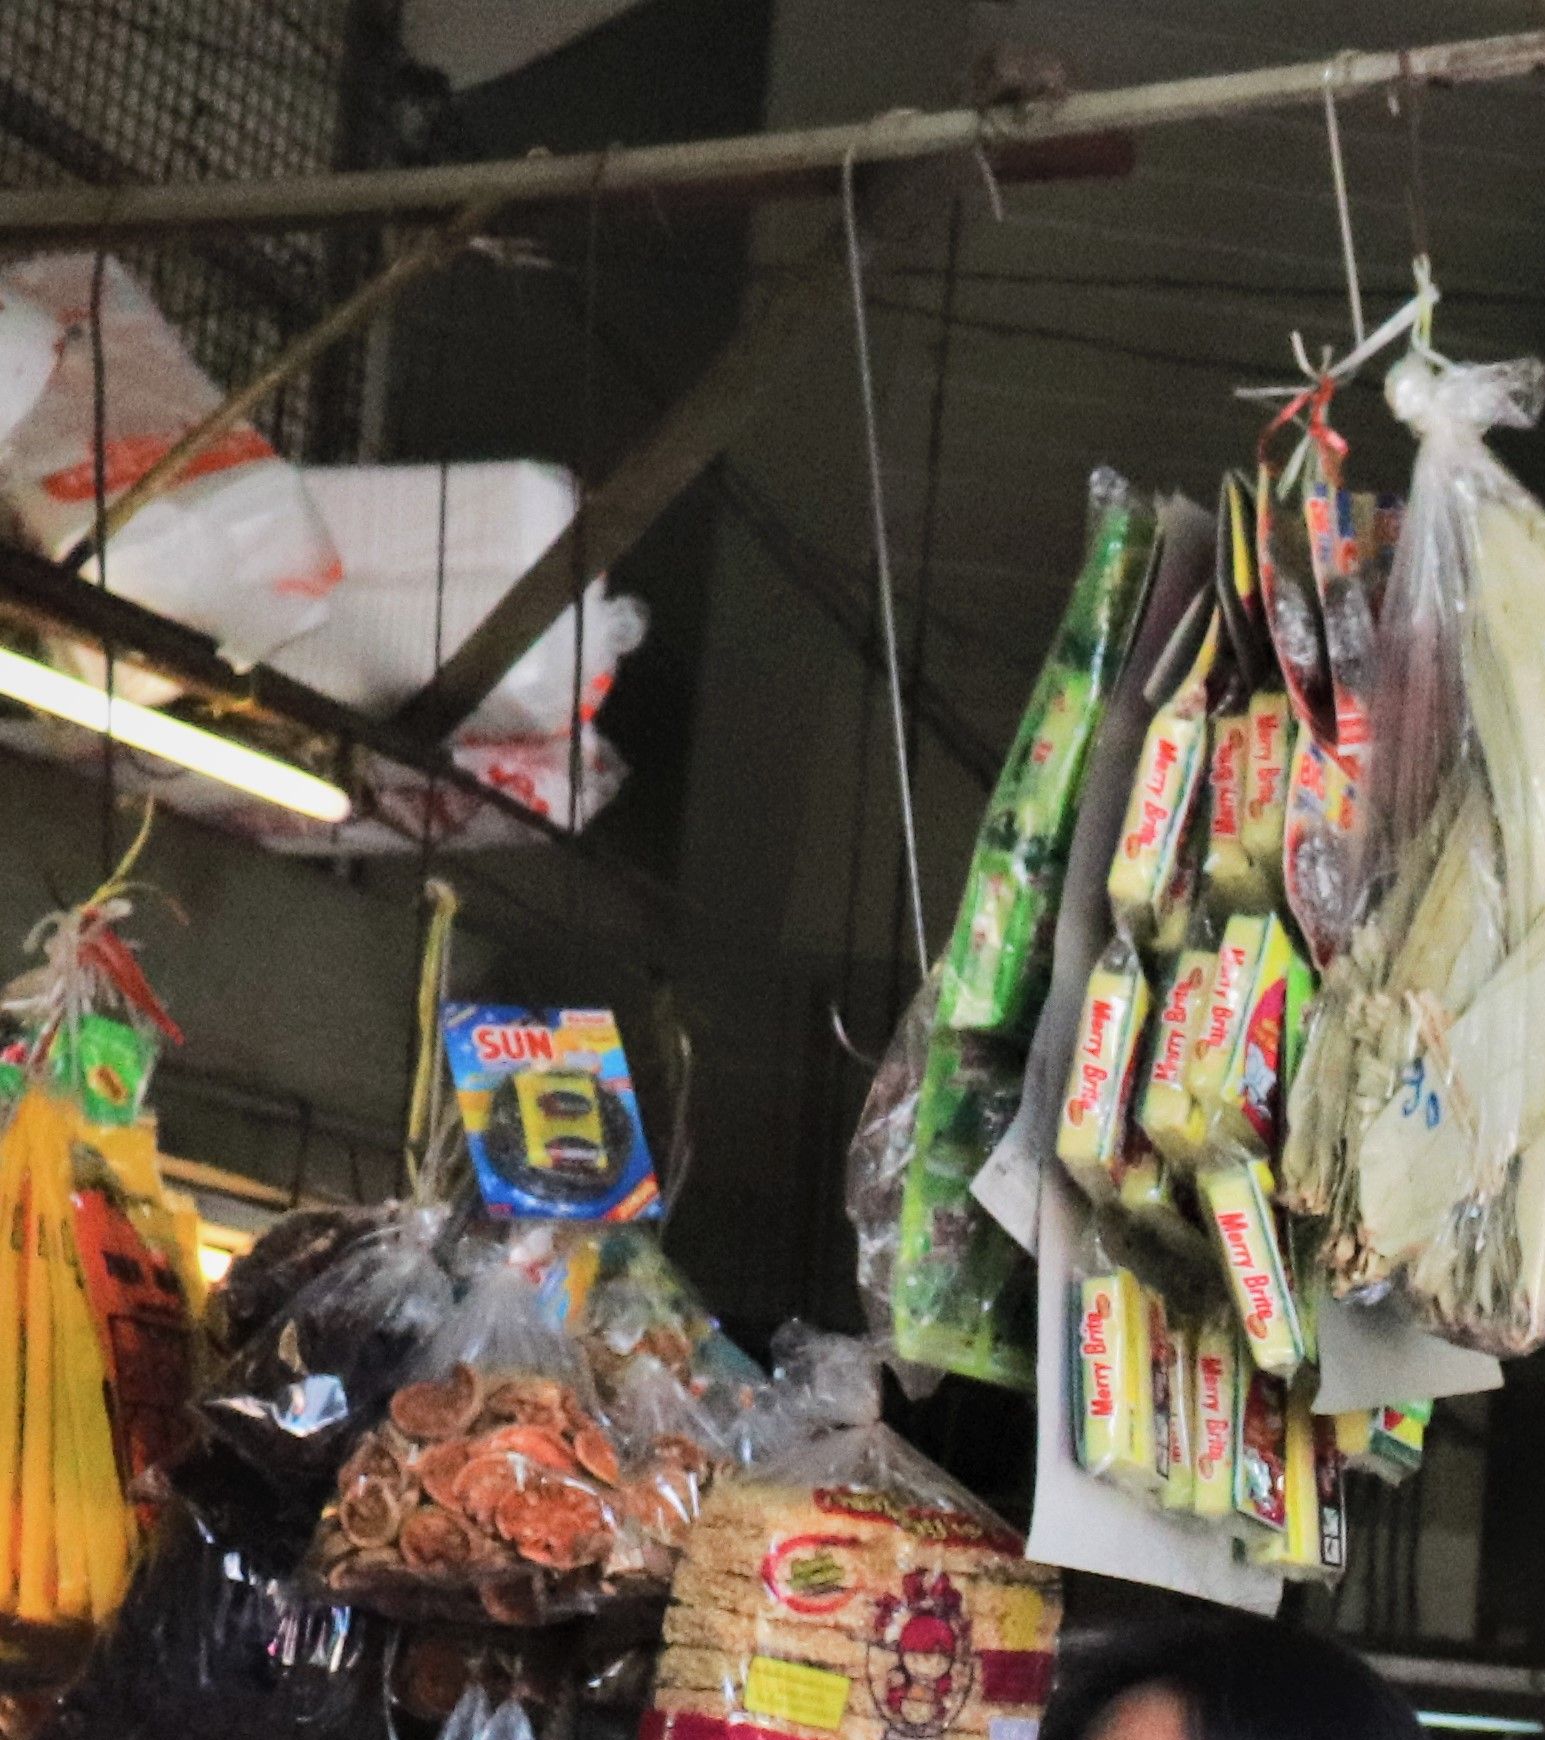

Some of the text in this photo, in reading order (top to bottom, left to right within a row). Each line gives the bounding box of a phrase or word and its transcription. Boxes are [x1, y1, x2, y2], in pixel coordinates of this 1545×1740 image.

[477, 1027, 555, 1062] SUN
[1084, 999, 1113, 1058] Merry
[1217, 1212, 1273, 1320] Merry Brite
[1083, 1311, 1113, 1416] Merry Brite
[1201, 1356, 1224, 1412] Merry
